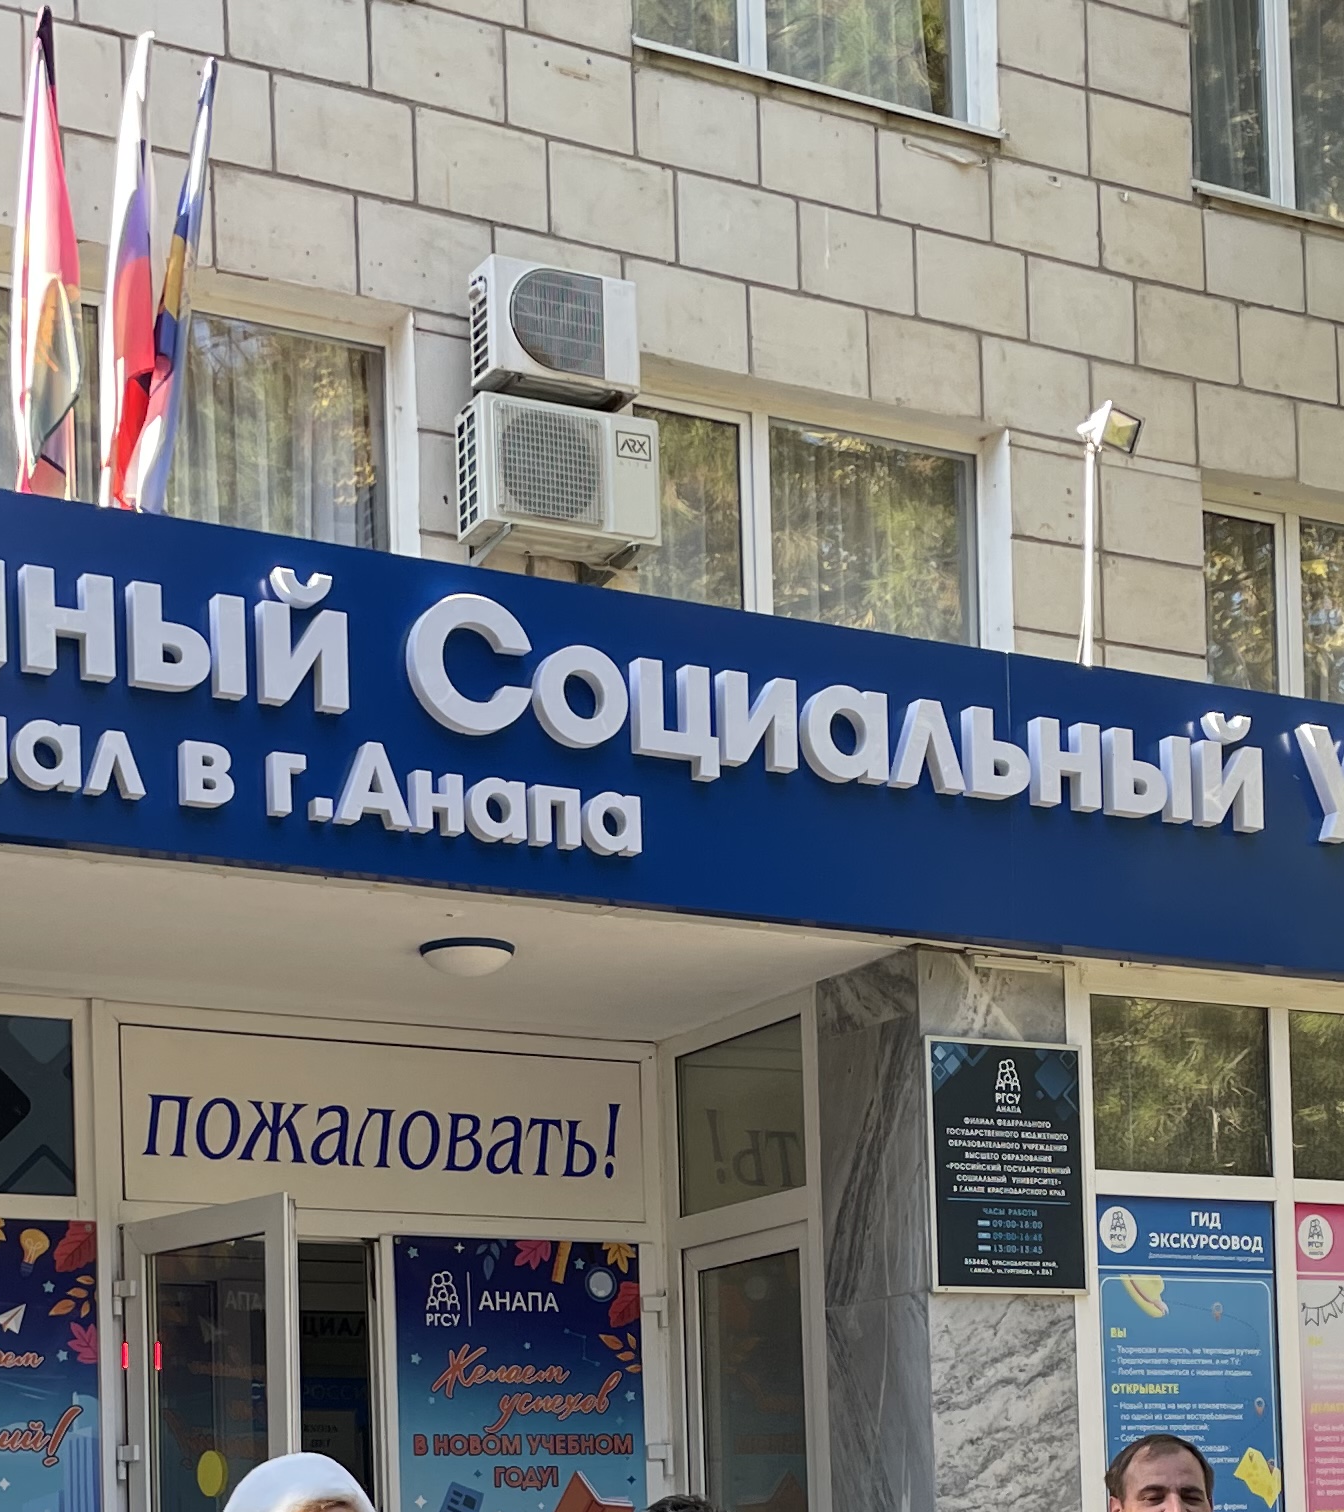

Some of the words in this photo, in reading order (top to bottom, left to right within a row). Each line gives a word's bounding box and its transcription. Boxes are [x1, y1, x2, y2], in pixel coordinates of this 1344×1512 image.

[620, 438, 648, 456] ARX
[405, 592, 1265, 834] Социальный
[179, 738, 234, 810] в
[265, 738, 644, 857] г.Анапа
[995, 1093, 1022, 1105] РГСУ
[996, 1106, 1022, 1114] АНАПА
[963, 1117, 995, 1126] ФИЛИАЛ
[996, 1118, 1051, 1129] ФЕДЕРАЛЬНОГО
[142, 1092, 621, 1180] пожаловать!
[946, 1128, 1019, 1139] ГОСУДАРСТВЕННОГО
[948, 1139, 1020, 1150] ОБРАЗОВАТЕЛЬНОГО
[982, 1208, 1006, 1216] ЧАСЫ
[1008, 1208, 1038, 1217] РАБОТЫ
[1190, 1211, 1222, 1230] ГИД
[1148, 1232, 1264, 1253] ЭКСКУРСОВОД
[478, 1290, 560, 1313] АНАПА
[425, 1313, 461, 1327] РГСУ
[1110, 1327, 1127, 1339] ВЫ
[431, 1344, 570, 1399] Желаем
[1111, 1383, 1180, 1394] ОТКРЫВАЕТЕ
[484, 1370, 622, 1433] успехов
[413, 1433, 429, 1456] В
[432, 1433, 522, 1456] НОВОМ
[528, 1433, 634, 1455] УЧЕБНОМ
[494, 1465, 560, 1490] ГОДУ!
